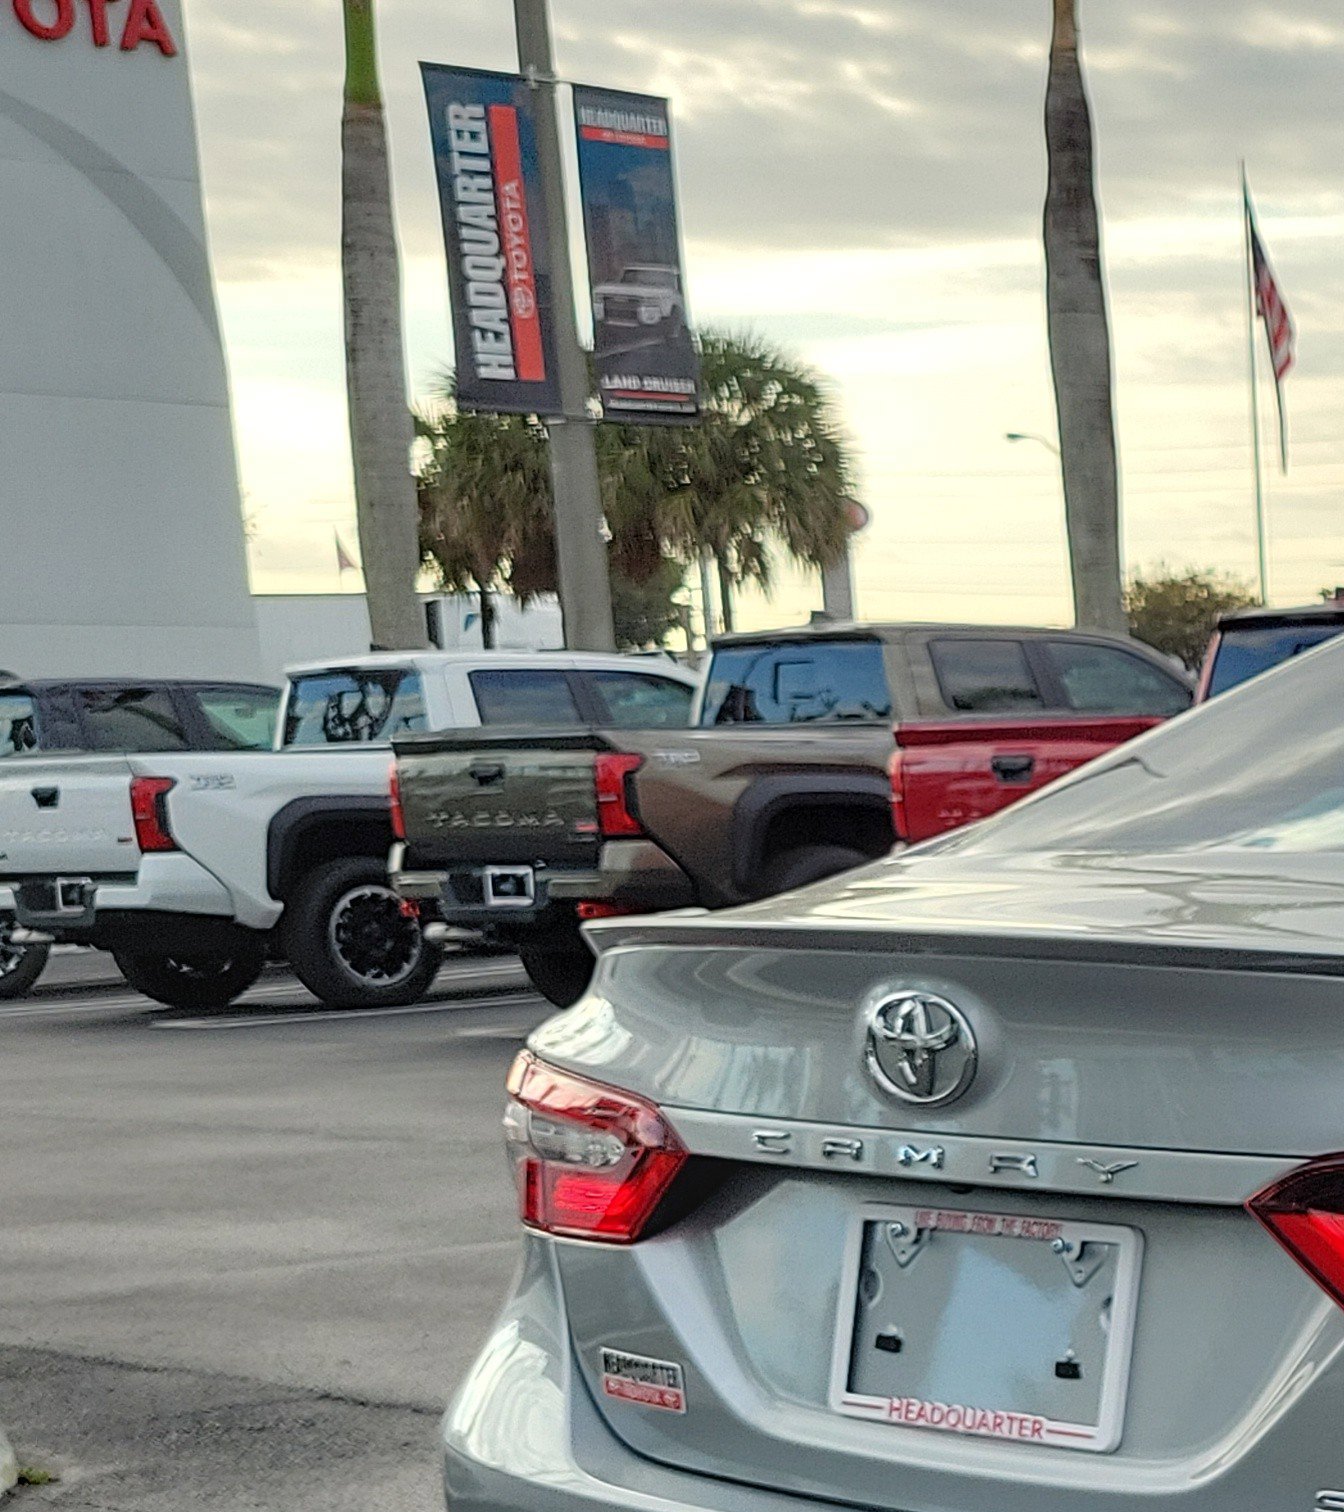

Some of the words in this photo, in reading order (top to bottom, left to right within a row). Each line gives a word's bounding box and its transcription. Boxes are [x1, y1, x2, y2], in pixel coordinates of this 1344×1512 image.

[447, 102, 517, 380] HEADQUARTER
[502, 178, 530, 280] TOYOTA
[425, 811, 565, 829] TACOMA
[751, 1128, 1140, 1184] CAMRY
[888, 1397, 1046, 1440] HEADQUARTER
